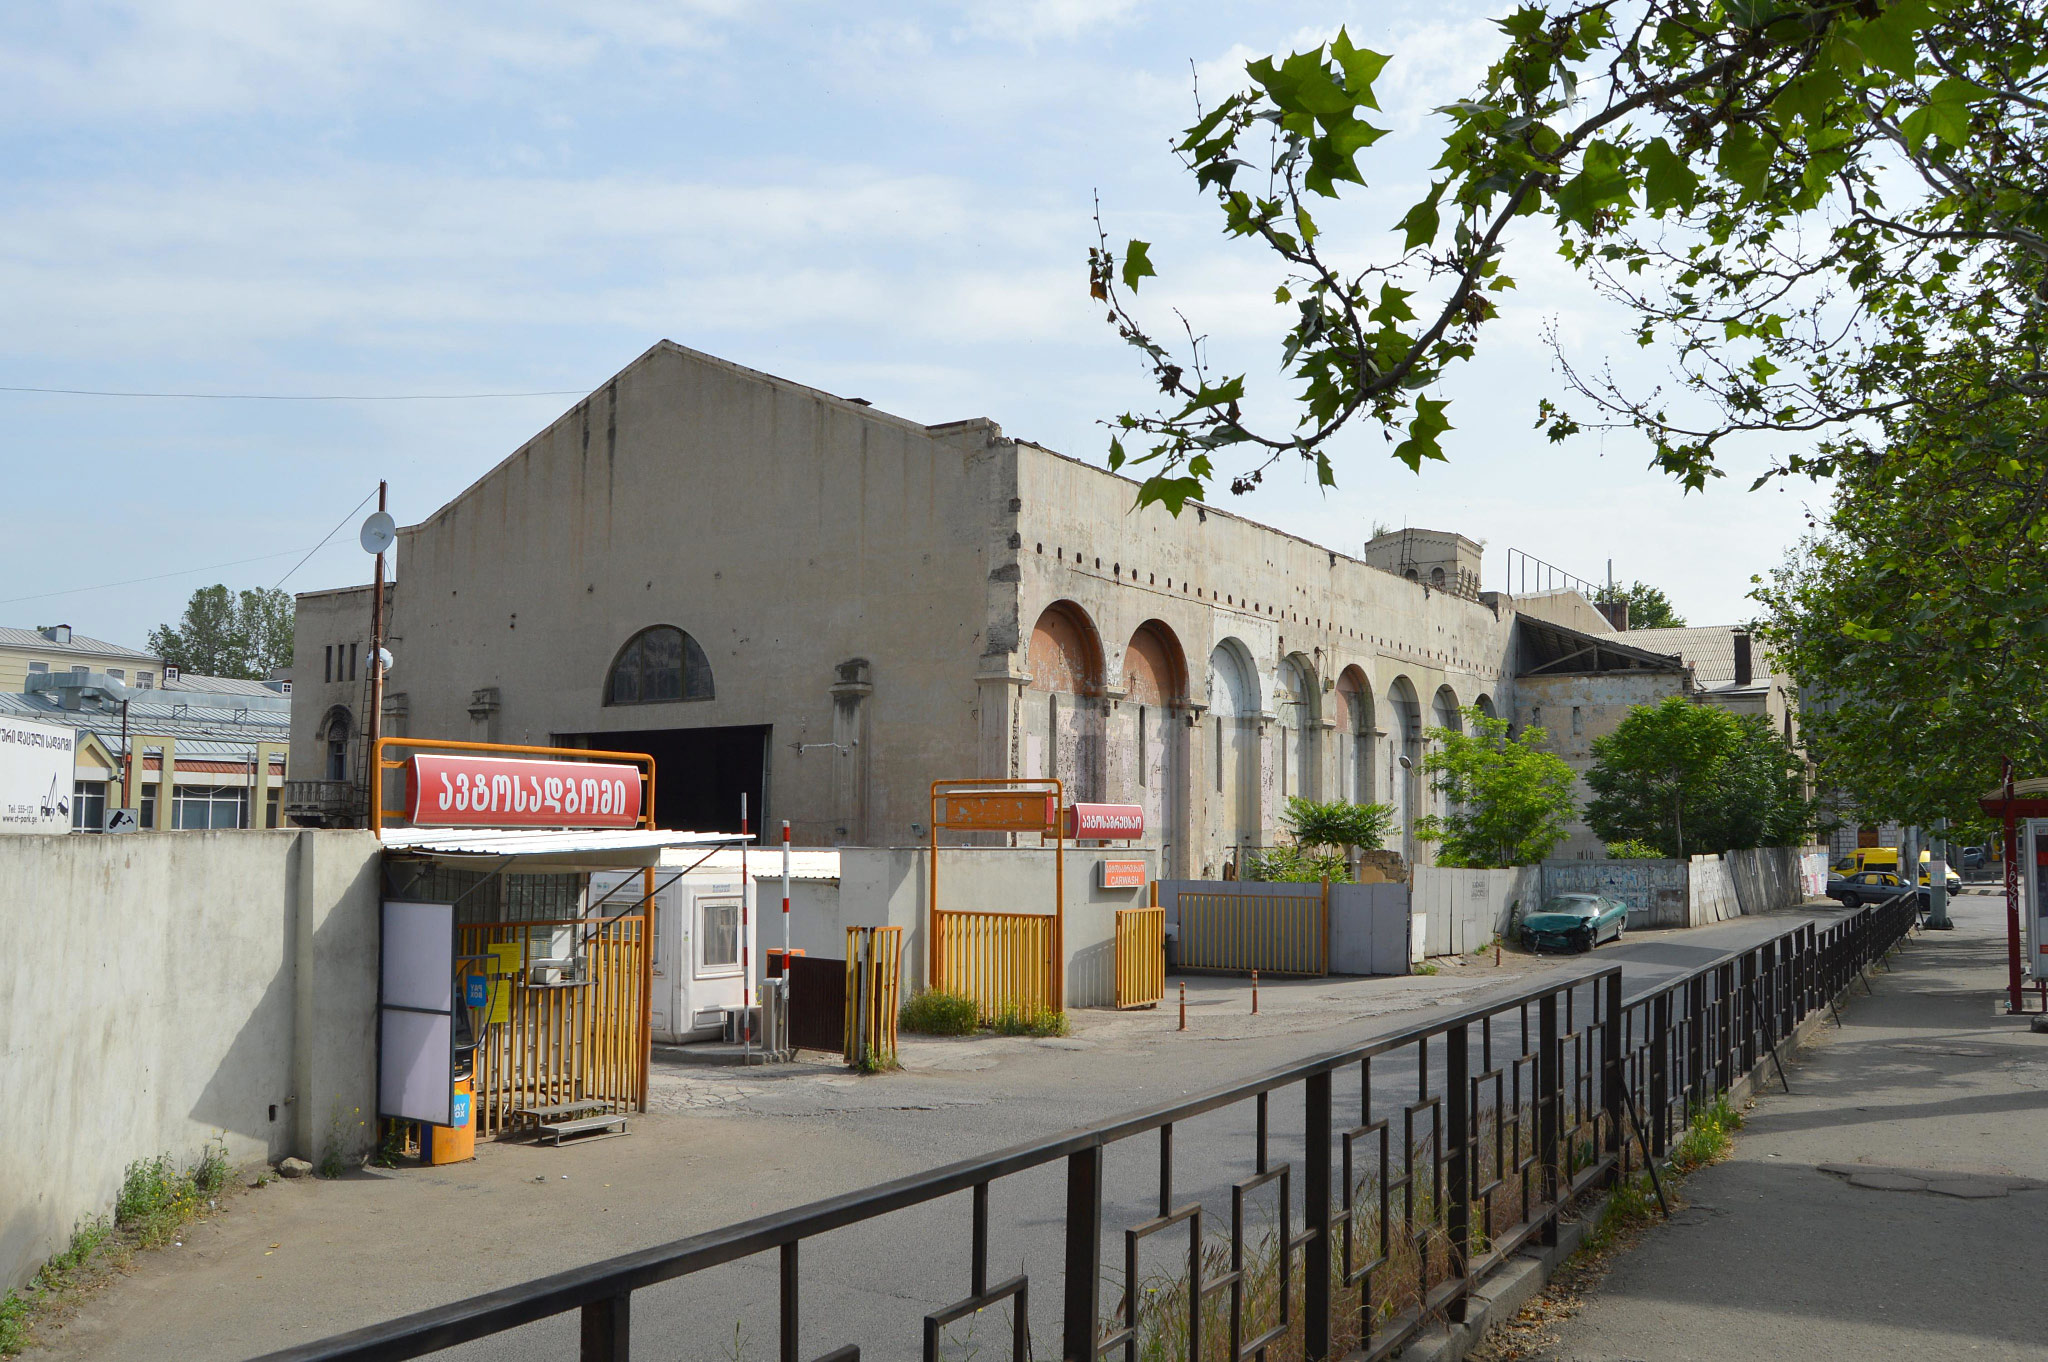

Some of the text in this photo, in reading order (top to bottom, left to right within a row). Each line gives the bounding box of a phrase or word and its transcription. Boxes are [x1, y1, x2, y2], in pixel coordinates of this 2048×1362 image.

[0, 728, 16, 744] ური
[438, 771, 627, 815] ავტოსადგომი
[1082, 814, 1142, 830] ავტოსამრეცხაო
[1110, 875, 1139, 886] CARWASH
